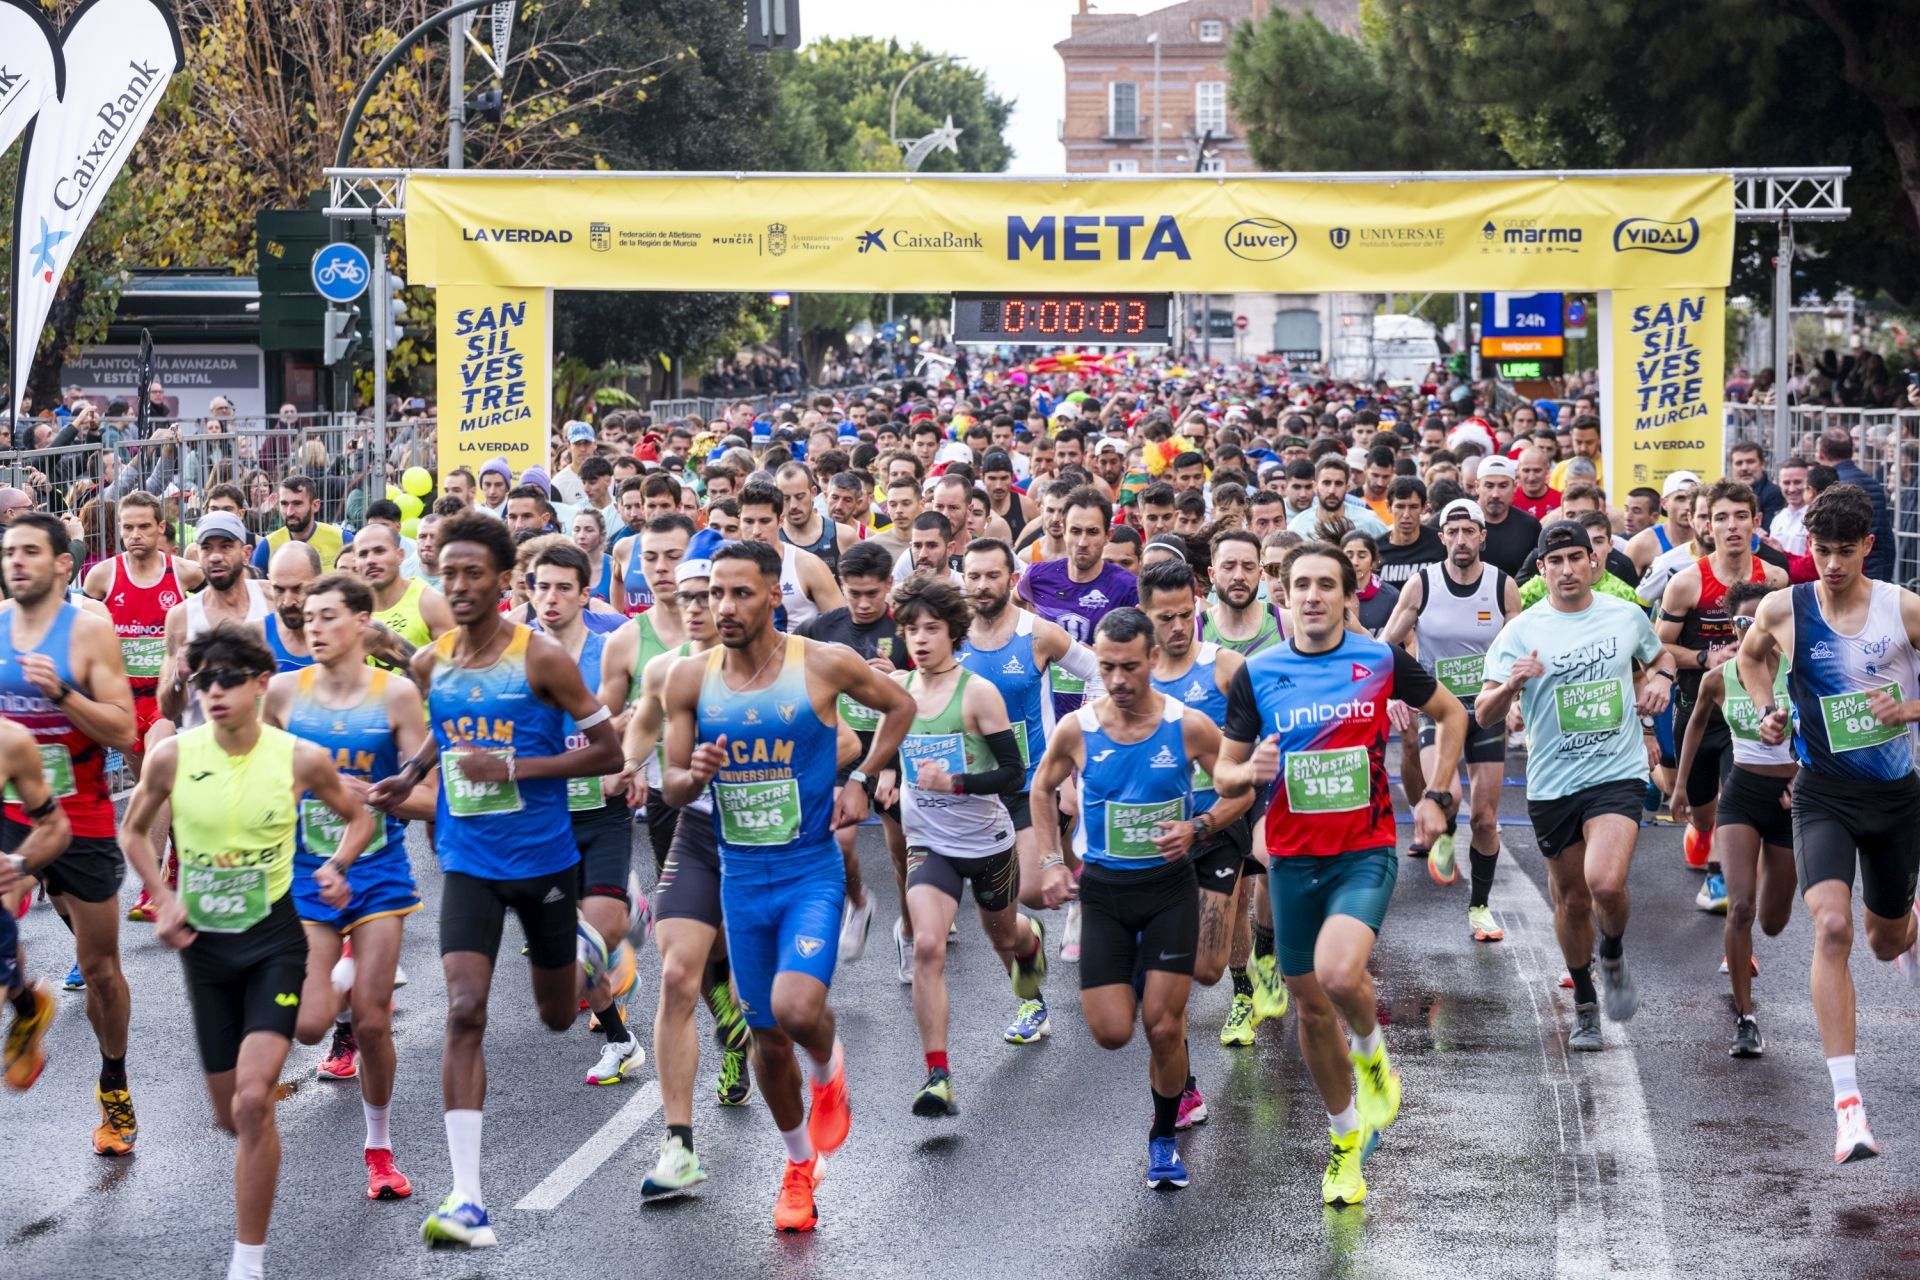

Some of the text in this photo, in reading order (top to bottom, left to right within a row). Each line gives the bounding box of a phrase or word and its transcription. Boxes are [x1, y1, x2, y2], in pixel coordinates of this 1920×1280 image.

[54, 59, 160, 211] CaixaBank
[463, 228, 573, 243] LA VERDAD
[619, 230, 656, 238] Federación
[668, 231, 701, 239] Atletismo
[893, 229, 984, 249] CaixaBank
[1007, 215, 1192, 261] META
[1233, 232, 1290, 248] Juver
[1360, 228, 1446, 240] UNIVERSAE
[1504, 228, 1582, 243] marmo
[1626, 228, 1688, 244] VIDAL
[637, 239, 660, 248] Región
[454, 301, 526, 336] SAN
[1003, 300, 1146, 334] 0:00:03
[1515, 313, 1546, 328] 24h
[1631, 296, 1706, 333] SAN
[465, 330, 516, 361] SIL
[1642, 326, 1694, 358] SIL
[171, 359, 238, 370] AVANZADA
[457, 353, 524, 388] VES
[1633, 350, 1701, 385] VES
[93, 371, 213, 384] Y ESTÉTA DENTAL
[459, 381, 526, 414] TRE
[1634, 377, 1703, 412] TRE
[460, 406, 532, 432] MURCIA
[1634, 403, 1708, 431] MURCIA
[459, 443, 529, 451] LA VERDAD
[1634, 440, 1705, 450] LA VERDAD
[126, 655, 162, 666] 2265
[1443, 659, 1461, 670] SAN
[1443, 658, 1485, 678] SILVESTR
[1563, 686, 1585, 700] SAN
[1563, 682, 1617, 708] SILVESTRE
[1575, 702, 1611, 719] 476
[1831, 696, 1856, 713] SAN
[1832, 687, 1895, 722] SILVESE
[1292, 755, 1320, 771] SAN
[1293, 751, 1362, 781] SILVESTRE
[1334, 762, 1362, 776] MURCIA
[719, 767, 793, 782] UNIVERSIDAD
[567, 782, 591, 797] 55
[723, 788, 748, 801] SAN
[1304, 776, 1355, 796] 3152
[724, 784, 791, 811] SILVESTRE
[733, 808, 784, 828] 1326
[1114, 808, 1141, 819] SAN
[1114, 802, 1179, 828] SILVESTRE
[1122, 827, 1167, 843] 358
[198, 893, 247, 914] 092
